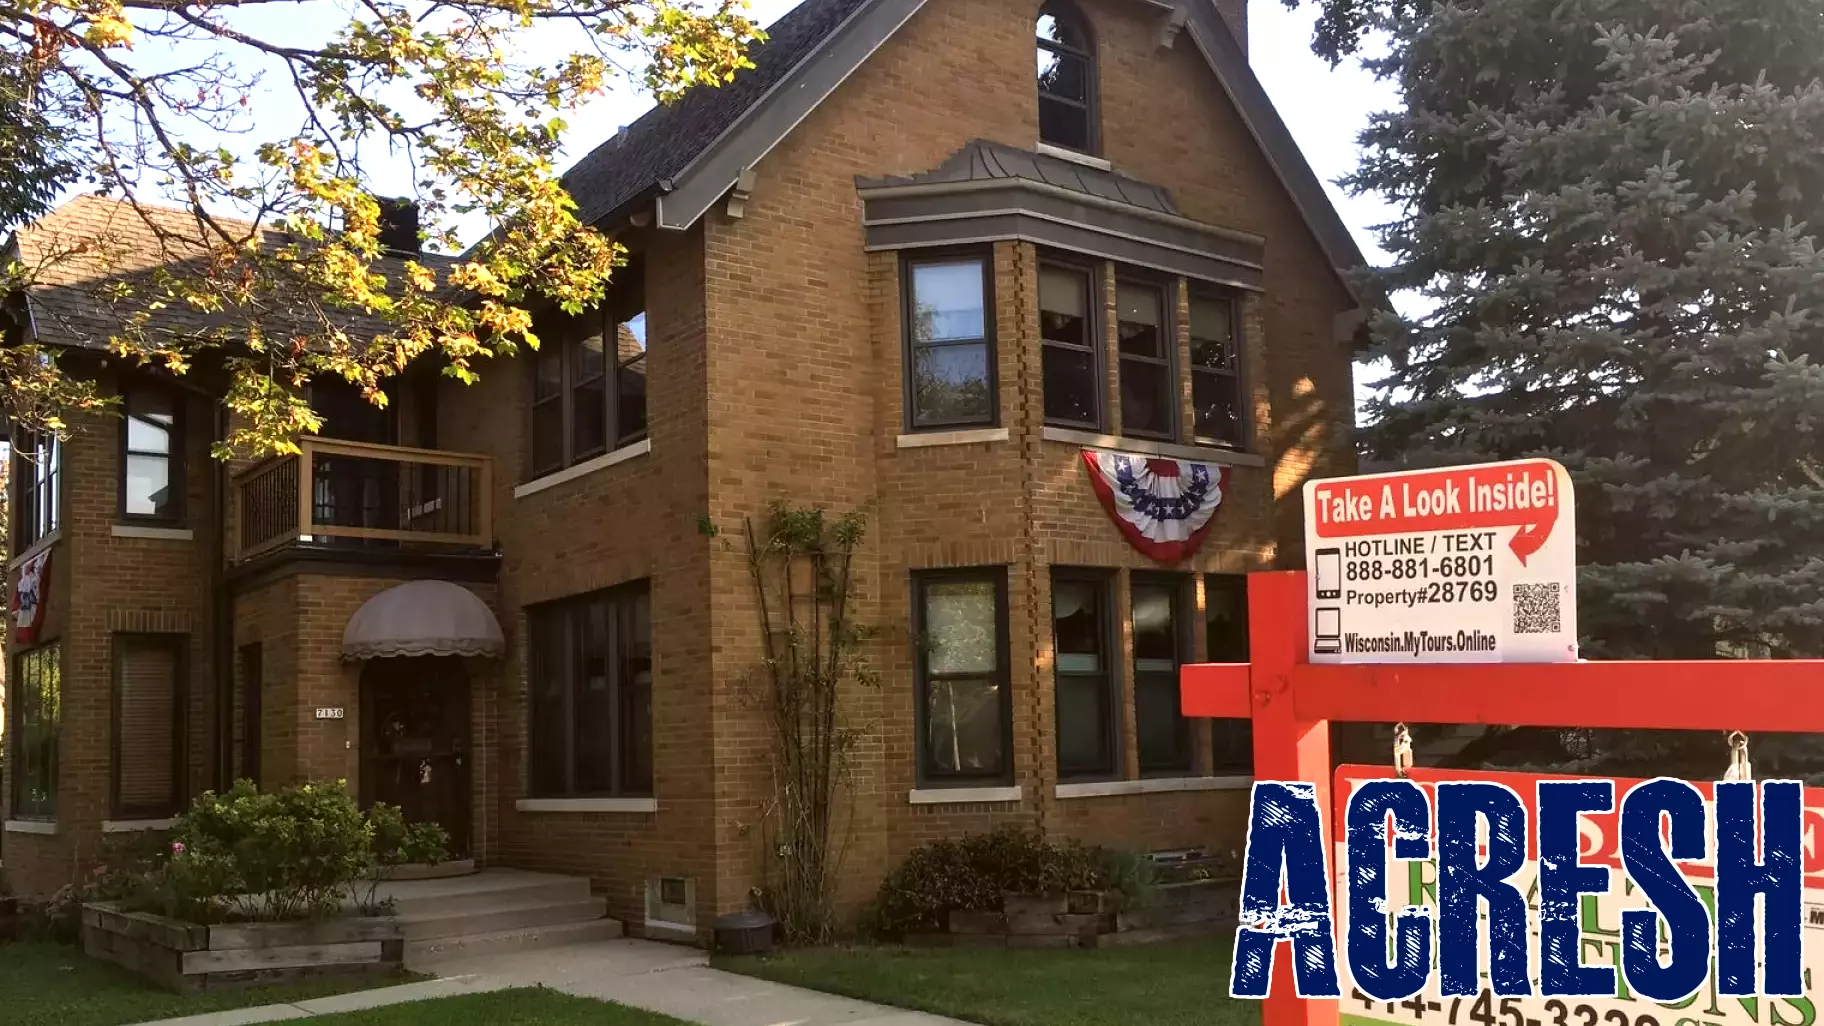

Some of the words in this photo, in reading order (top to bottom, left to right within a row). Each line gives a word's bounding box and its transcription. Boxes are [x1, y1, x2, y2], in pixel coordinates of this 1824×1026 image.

[1317, 489, 1373, 524] Take
[1379, 485, 1397, 519] A
[1403, 479, 1460, 517] Look
[1468, 470, 1555, 513] Inside!
[1345, 537, 1425, 557] HOTLINE
[1430, 536, 1437, 553] /
[1442, 532, 1497, 552] TEXT
[1346, 555, 1494, 581] 888-881-6801
[1346, 580, 1498, 608] Property#28769
[1344, 629, 1496, 657] Wisconsin.MyTours.Online
